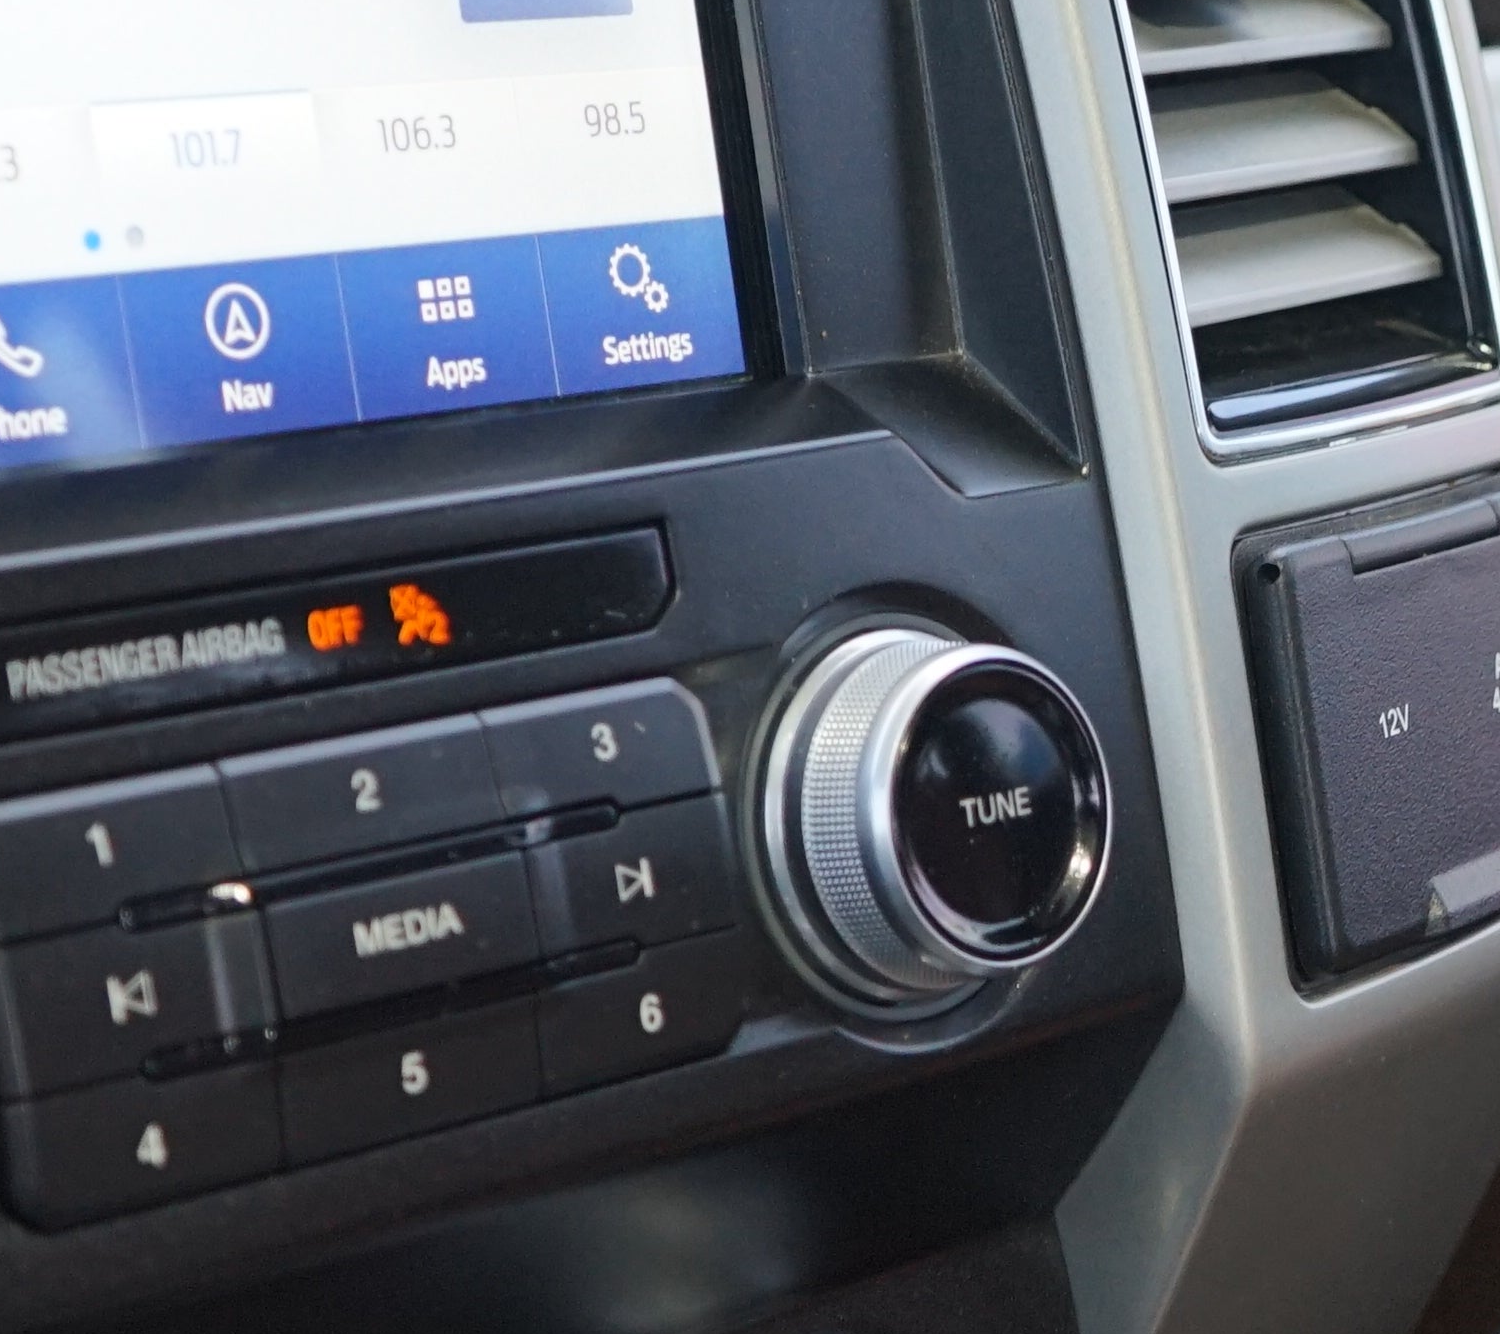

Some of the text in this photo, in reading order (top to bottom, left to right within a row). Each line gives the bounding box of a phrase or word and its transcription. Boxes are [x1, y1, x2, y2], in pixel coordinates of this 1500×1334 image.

[169, 128, 242, 169] 101.7
[377, 114, 457, 154] 106.3
[583, 101, 647, 138] 98.5
[602, 330, 694, 367] Settings
[426, 355, 487, 391] Apps
[221, 378, 274, 414] Nav
[5, 604, 364, 701] PASSENGER AIRBAG OFF
[1379, 703, 1410, 739] 12V
[590, 723, 621, 763] 3
[350, 769, 381, 814] 2
[959, 785, 1033, 828] TUNE
[85, 822, 113, 866] 1
[351, 900, 466, 960] MEDIA
[637, 992, 665, 1034] 6
[400, 1051, 429, 1096] 5
[136, 1123, 168, 1171] 4
